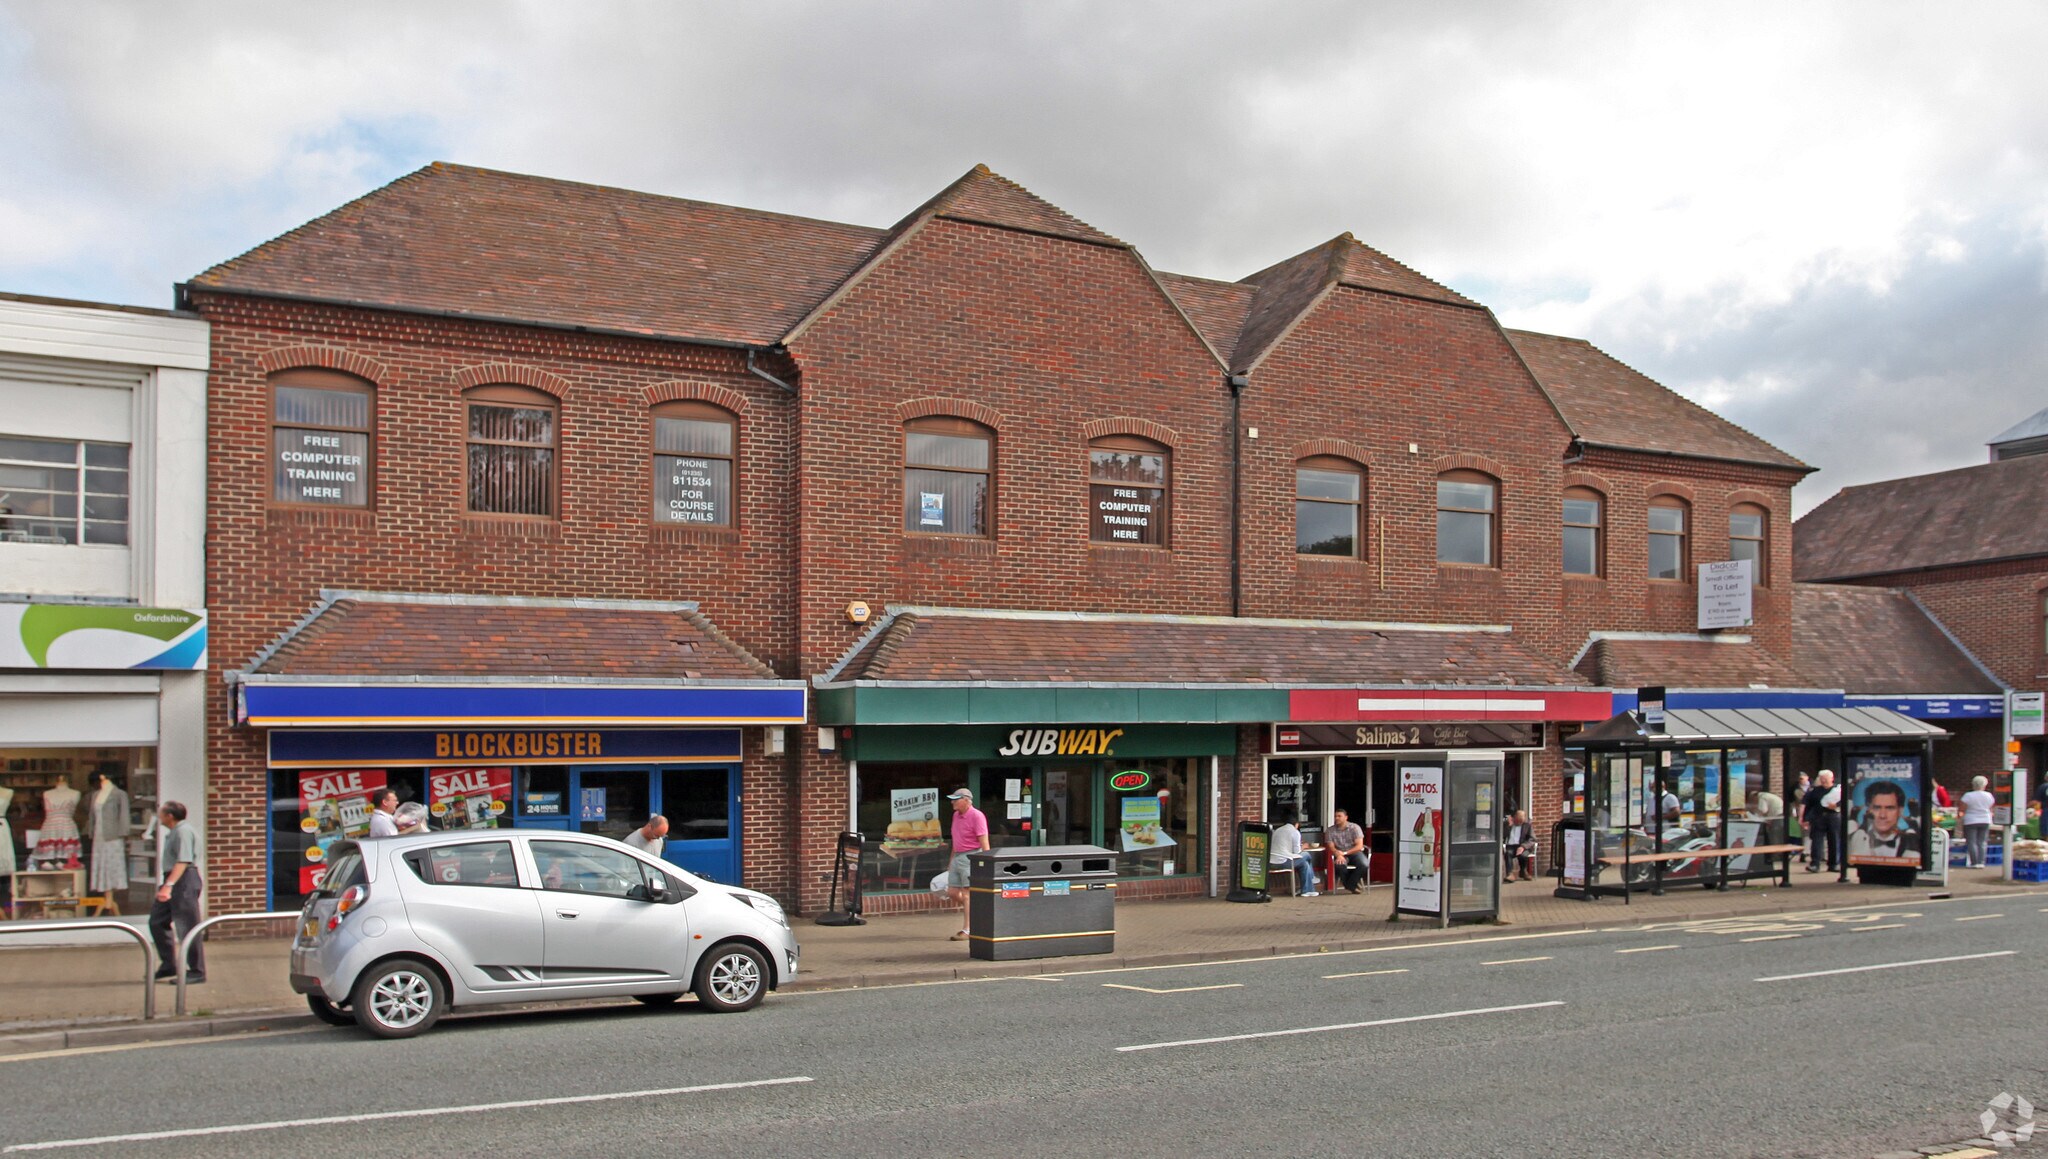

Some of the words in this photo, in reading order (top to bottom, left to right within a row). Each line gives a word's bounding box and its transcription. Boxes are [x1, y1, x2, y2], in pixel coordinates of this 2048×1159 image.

[303, 435, 340, 447] FREE
[281, 451, 361, 466] COMPUTER
[676, 459, 708, 469] PHONE
[286, 468, 356, 482] TRAINING
[672, 476, 711, 487] 811534
[302, 486, 341, 498] HERE
[681, 490, 703, 500] FOR
[1113, 489, 1137, 498] FREE
[670, 500, 714, 511] COURSE
[1099, 502, 1151, 513] COMPUTER
[670, 511, 714, 522] DETAILS
[1103, 516, 1147, 526] TRAINING
[1113, 530, 1138, 539] HERE
[133, 613, 190, 624] Oxfordshire
[1356, 727, 1406, 748] Salinas
[1410, 727, 1420, 744] 2
[1453, 728, 1470, 738] Bar
[436, 733, 602, 757] BLOCKBUSTER
[999, 728, 1124, 756] SUBWAY
[433, 770, 490, 797] SALE
[1115, 774, 1144, 787] OPEN
[1271, 773, 1304, 786] Salinas
[1306, 773, 1313, 784] 2
[302, 772, 363, 800] SALE
[922, 792, 936, 802] BBQ
[527, 805, 541, 814] 24
[1246, 836, 1265, 849] 10%
